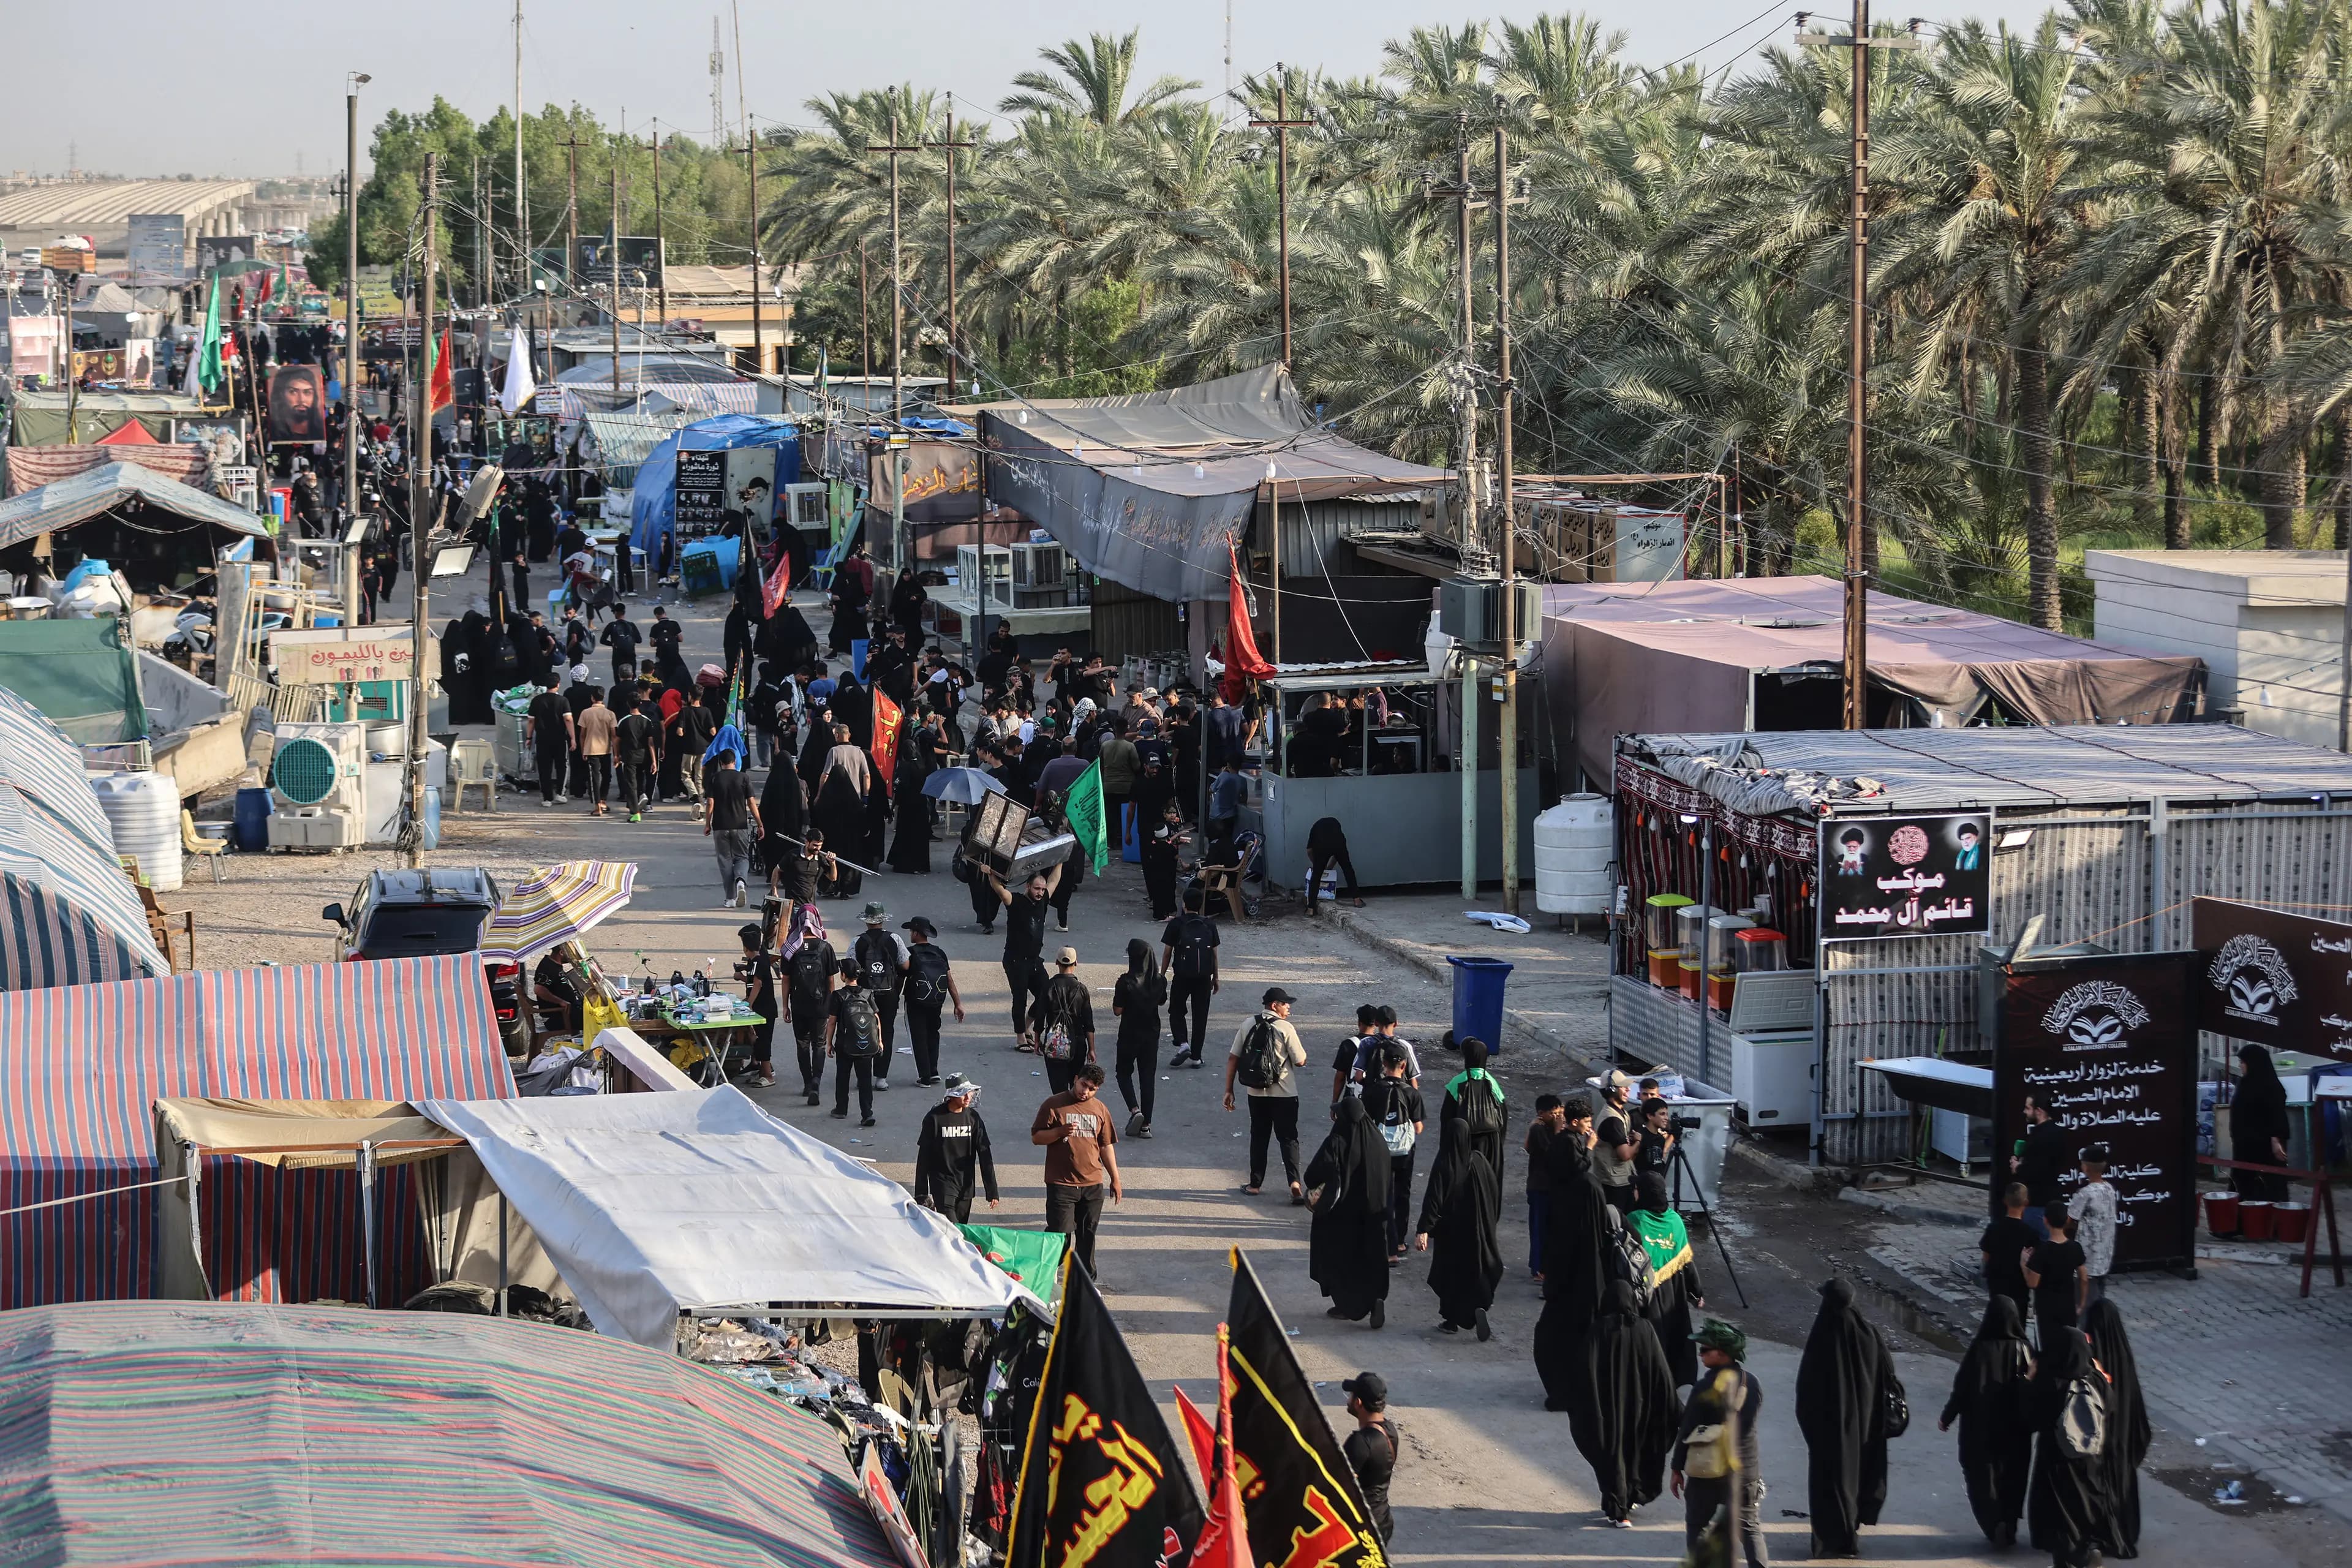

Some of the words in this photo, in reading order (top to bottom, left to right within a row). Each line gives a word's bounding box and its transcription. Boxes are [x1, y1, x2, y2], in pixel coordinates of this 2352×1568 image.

[682, 462, 705, 472] عاشوراء
[706, 462, 719, 472] ثورة
[1566, 534, 1582, 557] للرجال
[1597, 545, 1610, 567] للرجال
[311, 644, 384, 667] بالليمون
[1877, 867, 1945, 894] موكب
[1835, 907, 1892, 924] محمد
[1897, 897, 1920, 926] آل
[1923, 897, 1973, 927] قائم
[2241, 1011, 2261, 1022] UNIVERSITY
[2261, 1016, 2279, 1026] COLLEGE
[2024, 1060, 2084, 1085] أربعينية
[2084, 1062, 2117, 1081] لزوار
[2118, 1059, 2165, 1076] خدمة
[2051, 1087, 2102, 1107] الحسين
[2079, 1109, 2127, 1126] الصلاة
[2127, 1107, 2162, 1126] عليه
[941, 1125, 971, 1137] MHZ!
[2119, 1164, 2162, 1180] كلية
[2122, 1188, 2171, 1205] موكب
